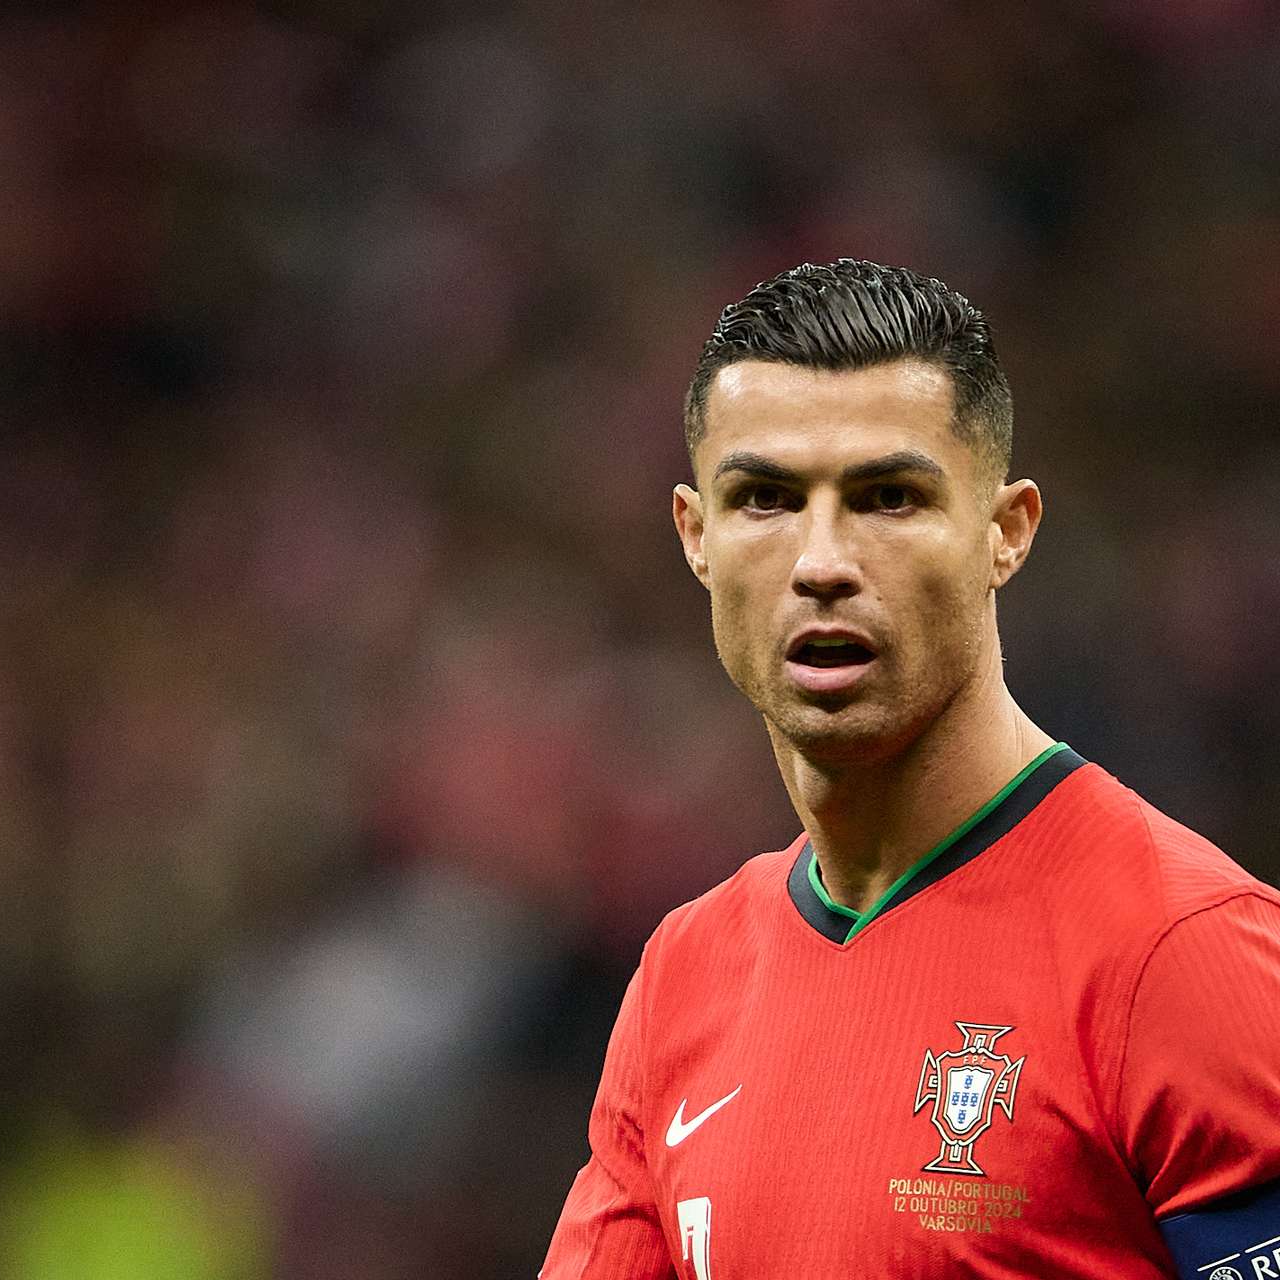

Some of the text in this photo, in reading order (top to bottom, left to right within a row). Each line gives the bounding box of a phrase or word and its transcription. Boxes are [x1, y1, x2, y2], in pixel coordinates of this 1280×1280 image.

[894, 1196, 1022, 1218] 12 OUTUBRO 2024
